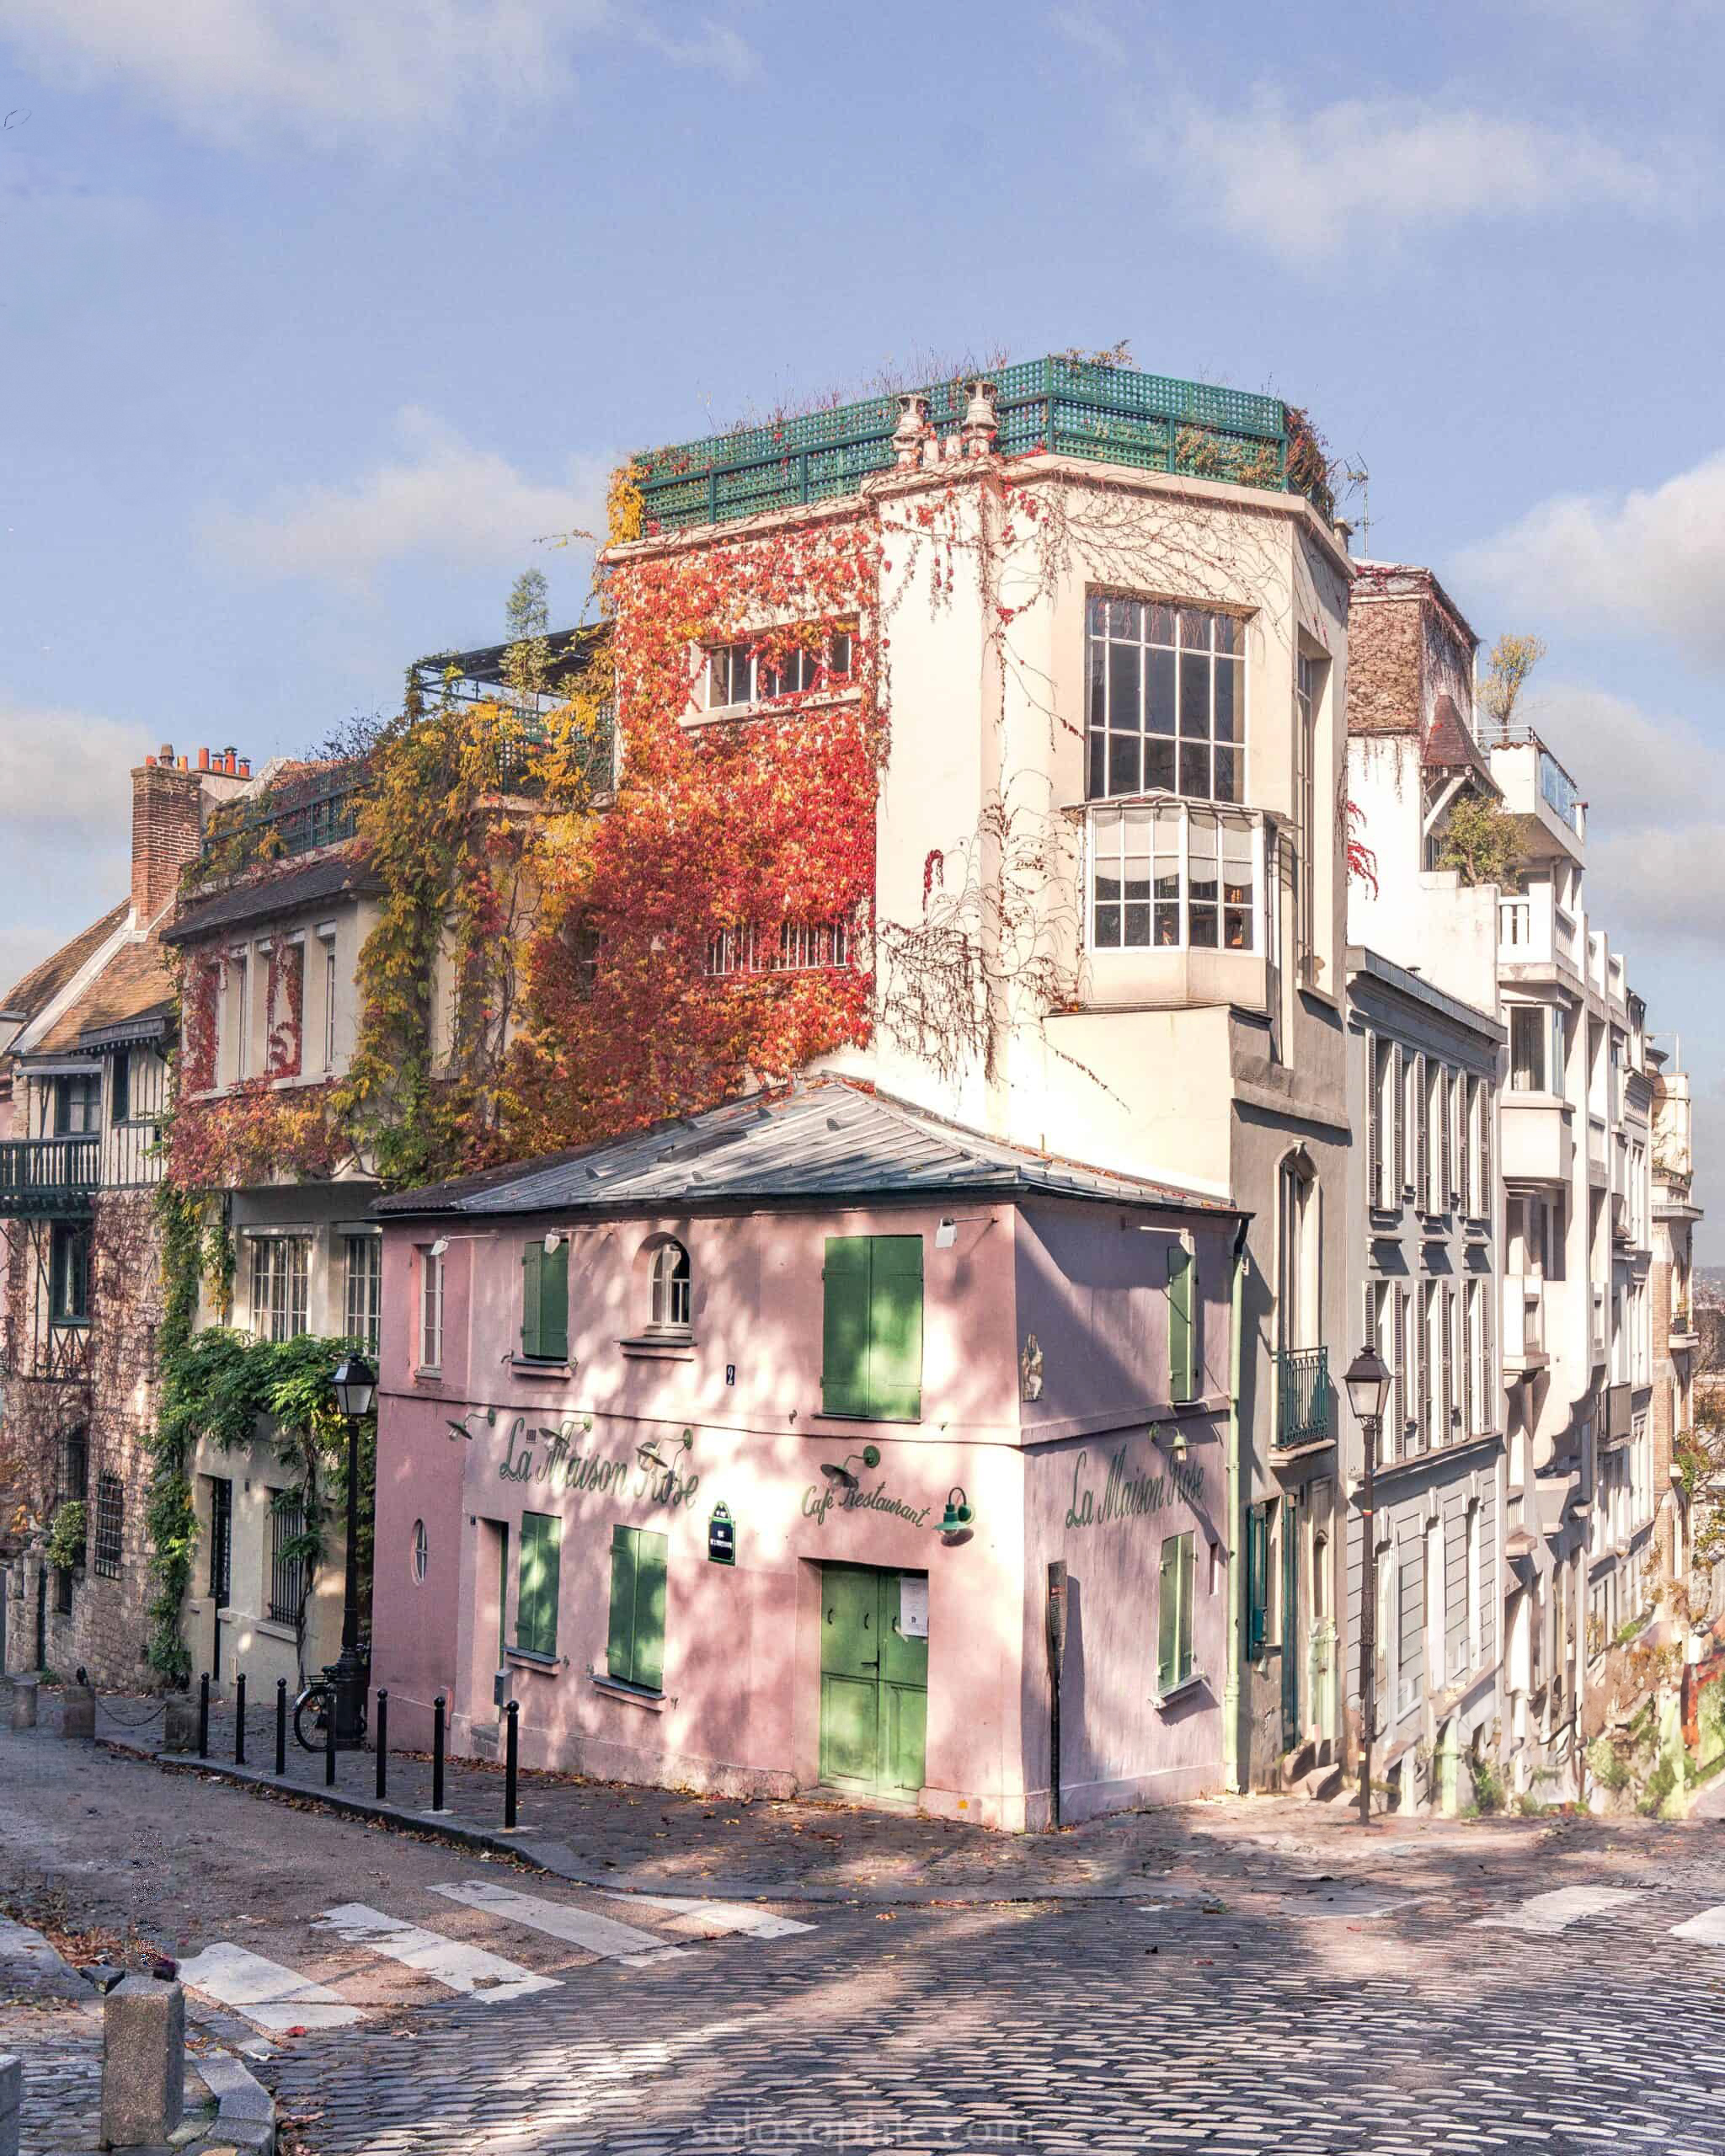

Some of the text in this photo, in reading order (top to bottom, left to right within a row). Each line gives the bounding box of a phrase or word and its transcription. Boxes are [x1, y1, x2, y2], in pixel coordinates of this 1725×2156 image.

[728, 1366, 734, 1384] 2
[499, 1417, 699, 1509] La Maison Rose
[1065, 1443, 1204, 1529] La Maison Rose
[801, 1477, 931, 1528] Café Restaurant
